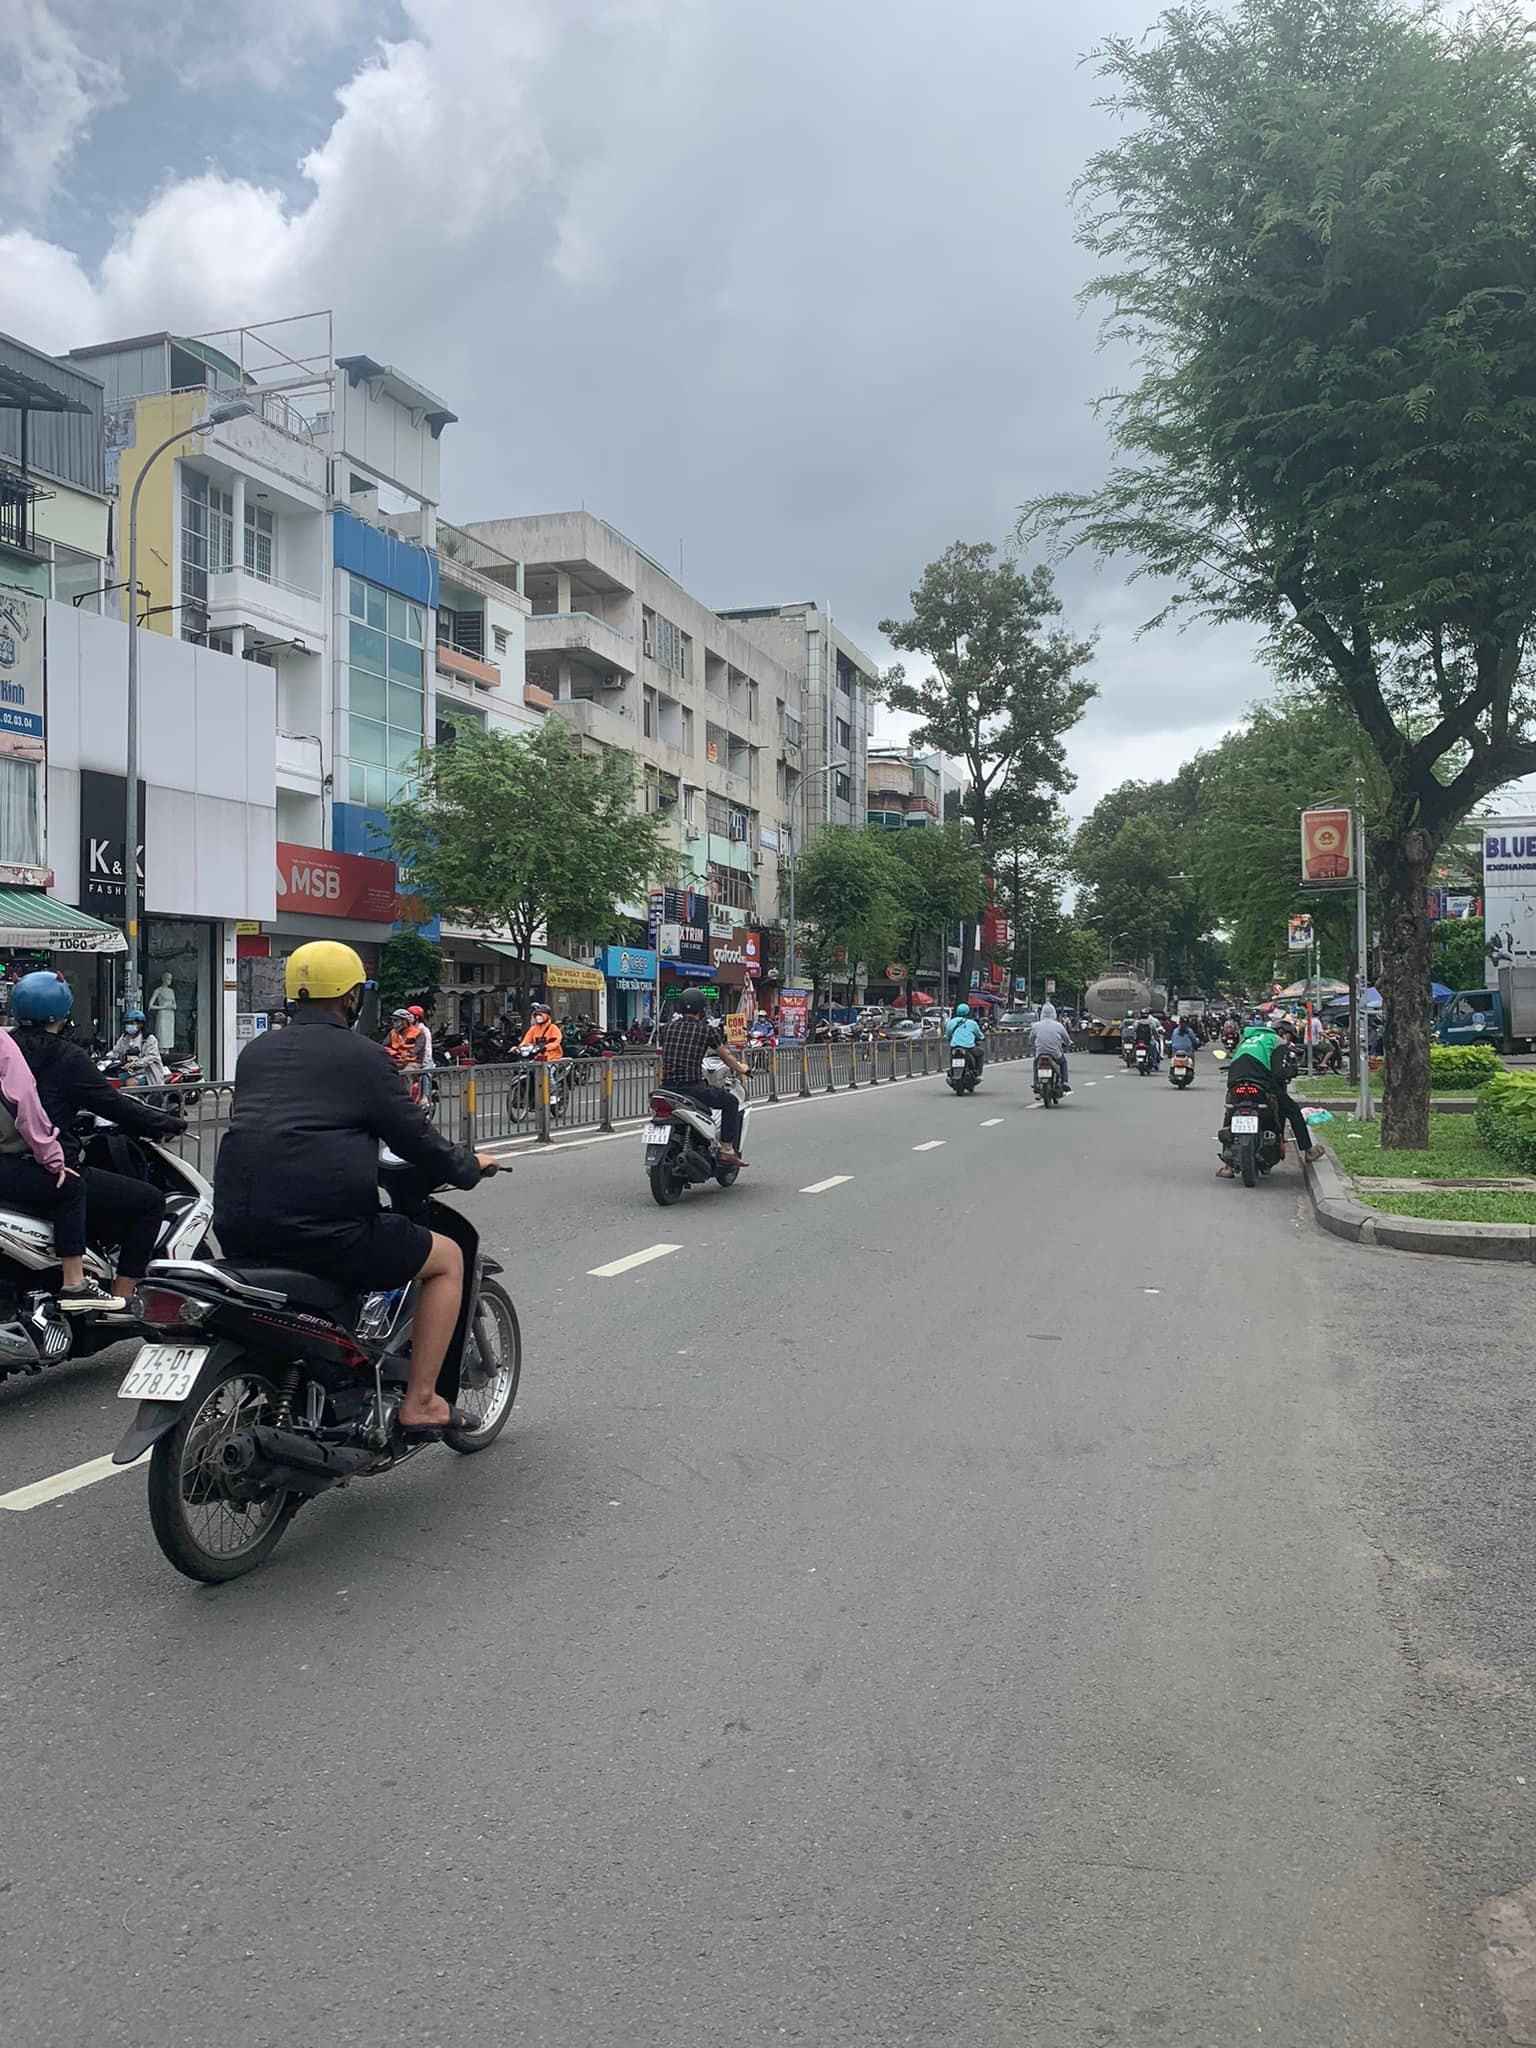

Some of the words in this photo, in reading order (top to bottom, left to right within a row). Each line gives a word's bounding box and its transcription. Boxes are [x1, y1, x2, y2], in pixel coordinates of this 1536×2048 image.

[90, 838, 110, 874] K
[112, 860, 123, 875] &
[1486, 837, 1536, 858] BLUE
[89, 884, 144, 897] FASHIN
[291, 864, 340, 899] MSB
[60, 939, 88, 950] TOGO
[143, 1349, 194, 1371] 74-D1
[124, 1373, 191, 1396] 278.73
